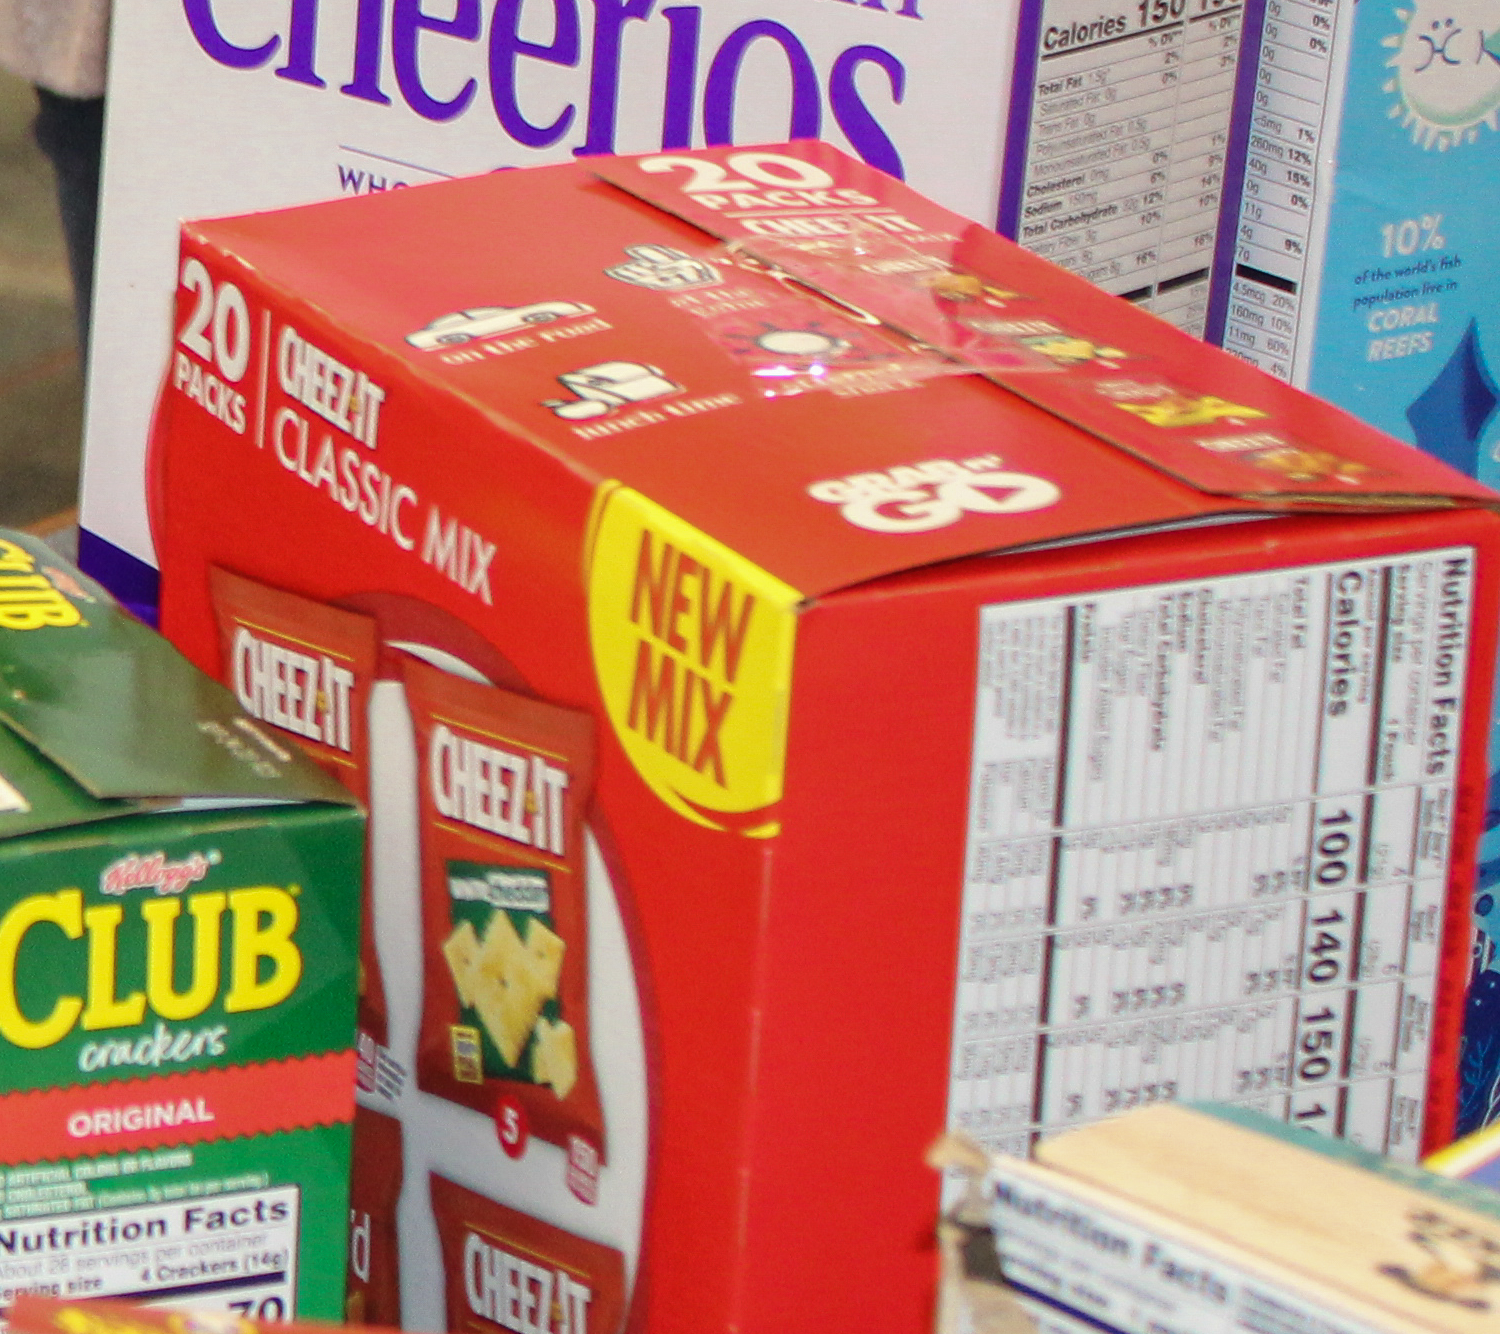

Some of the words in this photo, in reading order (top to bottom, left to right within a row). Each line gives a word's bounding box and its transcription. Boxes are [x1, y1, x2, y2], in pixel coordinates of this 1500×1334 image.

[1041, 16, 1127, 51] Calories
[1312, 14, 1330, 29] 0%
[1309, 37, 1327, 53] 0%
[639, 152, 834, 193] 20
[1287, 148, 1312, 166] 12%
[690, 190, 879, 212] PACKS
[1022, 222, 1049, 240] Total
[1380, 213, 1446, 260] 10%
[1354, 269, 1370, 286] of
[1372, 264, 1392, 283] the
[1394, 257, 1436, 280] world's
[1439, 253, 1462, 270] fish
[1353, 287, 1414, 311] population
[1416, 284, 1439, 300] live
[1442, 278, 1458, 294] in
[177, 257, 250, 382] 20
[1366, 303, 1438, 332] CORAL
[1367, 332, 1434, 363] REEFS
[176, 356, 247, 435] PACKS
[274, 407, 419, 550] CLASSIC
[421, 506, 498, 606] MIX
[629, 528, 757, 684] NEW
[1433, 557, 1470, 694] Nutrition
[1326, 569, 1364, 719] Calories
[626, 639, 734, 791] MIX
[1425, 697, 1460, 777] Facts
[1317, 807, 1353, 886] 100
[102, 855, 209, 895] Kellogg's
[1307, 909, 1342, 986] 140
[78, 1023, 227, 1073] crackers
[1298, 1007, 1334, 1083] 150
[67, 1098, 215, 1138] ORIGINAL
[503, 1105, 520, 1145] 5
[184, 1199, 290, 1234] Facts
[994, 1182, 1132, 1260] Nutrition
[1144, 1243, 1230, 1307] Facts
[67, 1276, 103, 1293] size
[156, 1254, 239, 1282] Crackers
